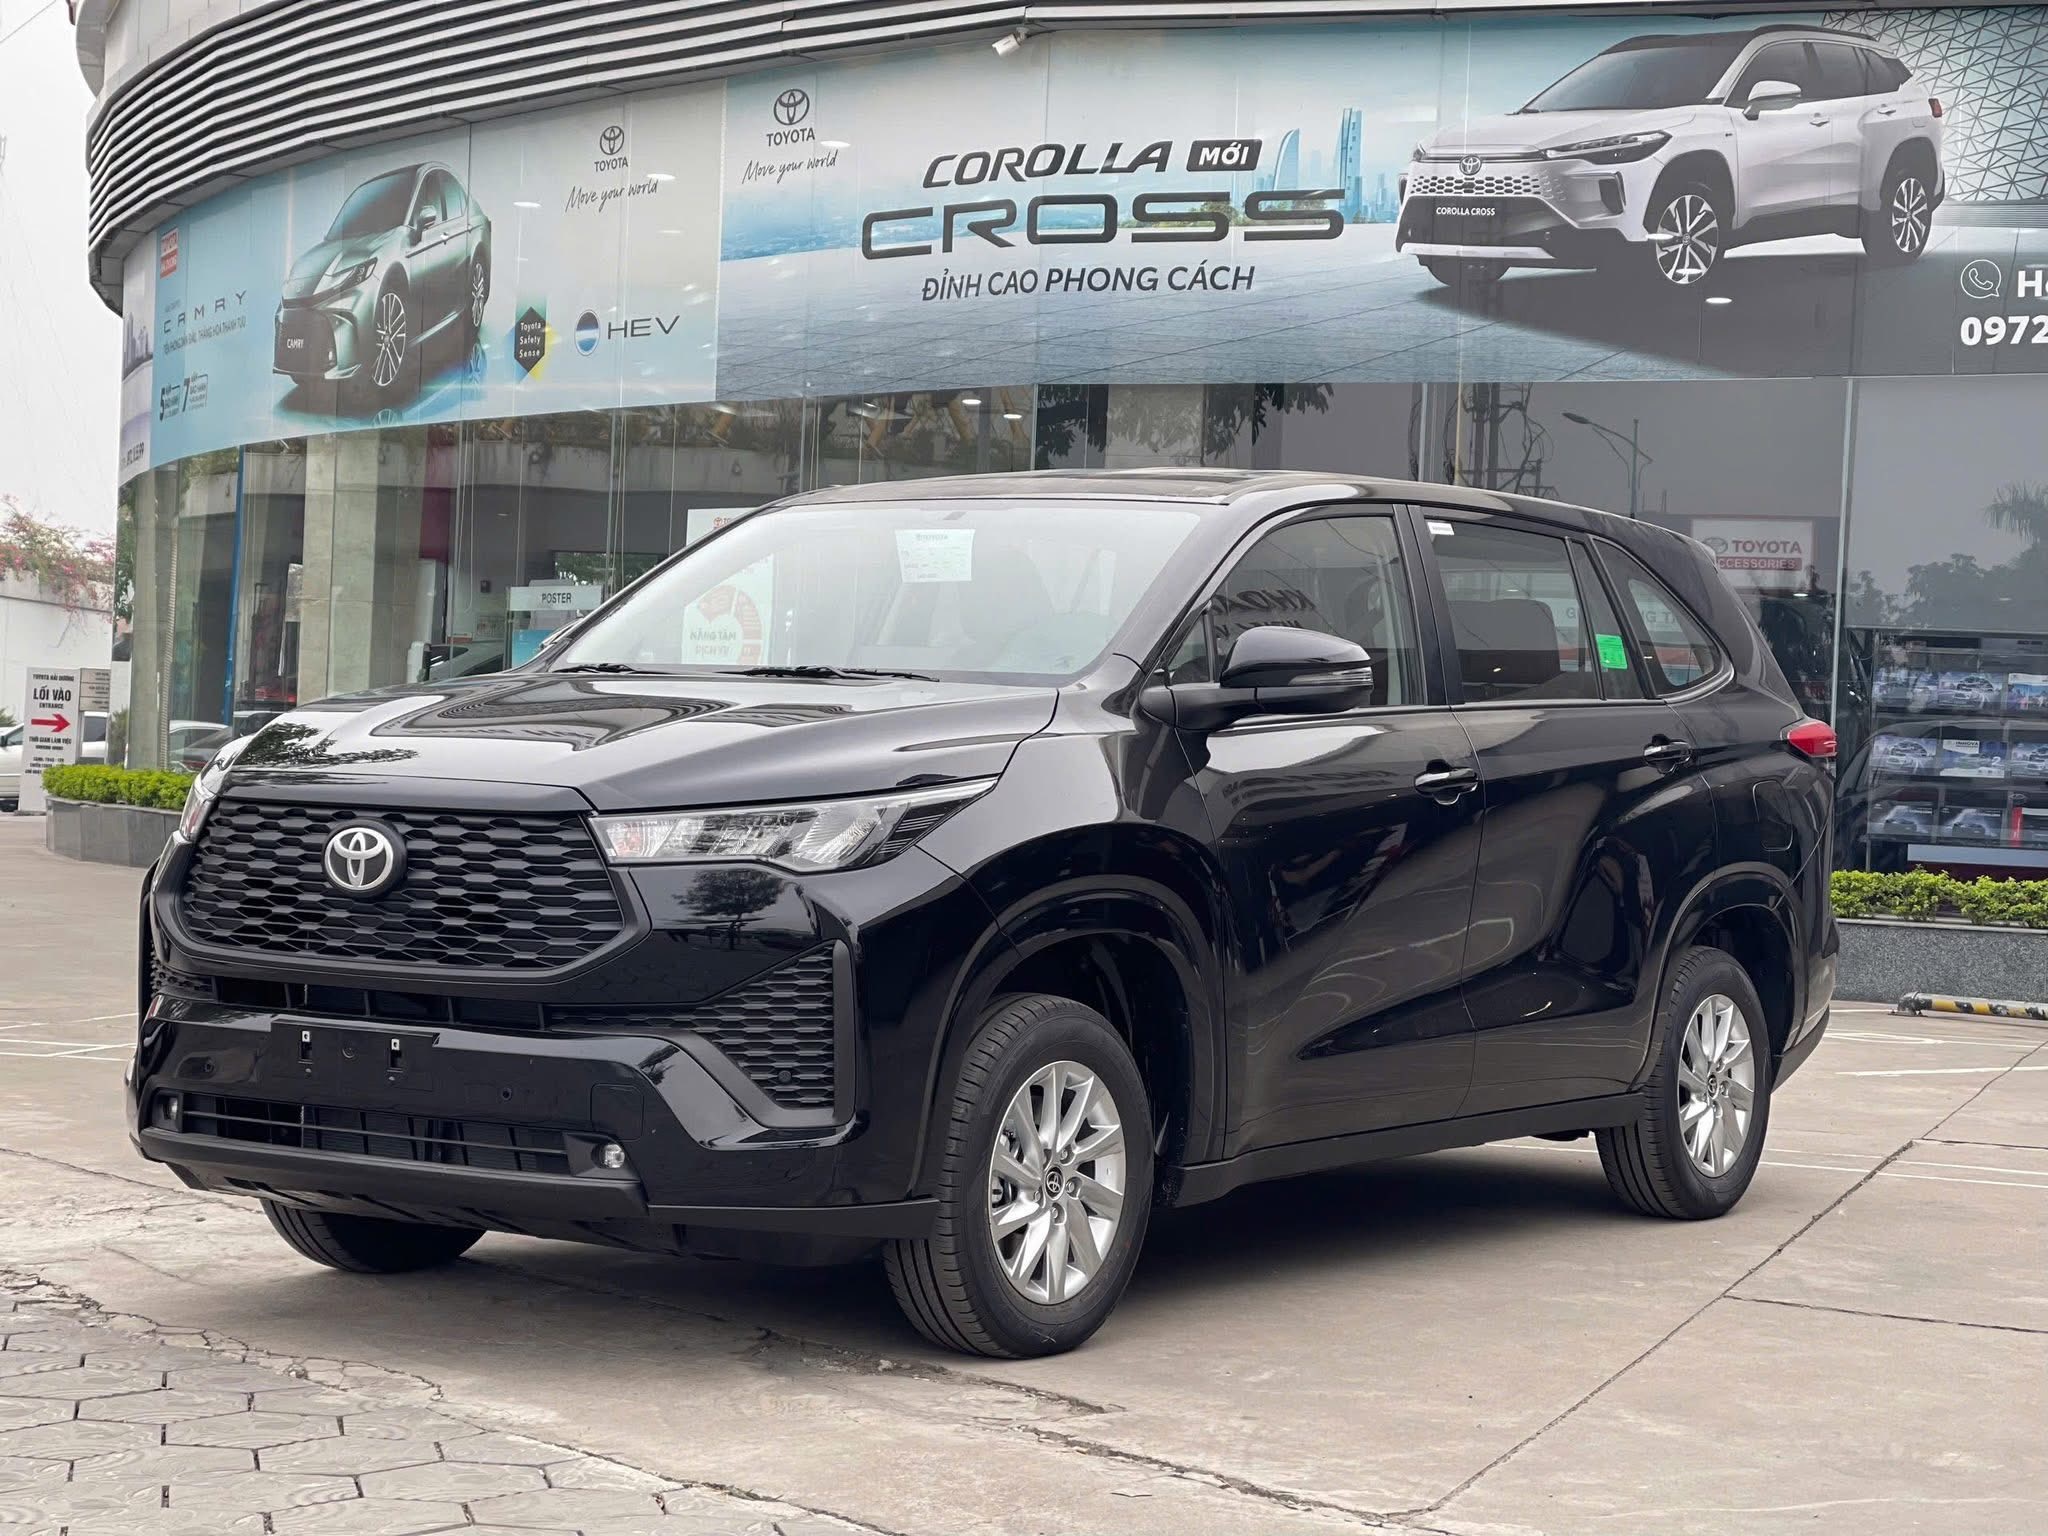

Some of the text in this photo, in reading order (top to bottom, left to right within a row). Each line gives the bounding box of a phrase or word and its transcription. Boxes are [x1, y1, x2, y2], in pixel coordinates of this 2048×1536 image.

[766, 127, 815, 147] TOYOTA
[594, 156, 629, 172] TOYOTA
[742, 149, 838, 184] Move your world
[922, 140, 1250, 188] COROLLA MỚI
[565, 179, 658, 213] Move your world
[1436, 206, 1496, 216] COROLLA CROSS
[861, 188, 1346, 260] CROSS
[921, 257, 1256, 302] ĐỈNH CAO PHONG CÁCH
[2017, 269, 2048, 297] H
[520, 321, 541, 332] Toyota
[607, 315, 681, 340] HEV
[519, 335, 541, 346] Safety
[519, 349, 540, 359] Sense
[1732, 539, 1802, 554] TOYOTA
[1717, 558, 1796, 569] CCESSORIES
[541, 592, 572, 604] POSTER
[33, 684, 50, 701] LỐI
[52, 686, 71, 702] VÀO
